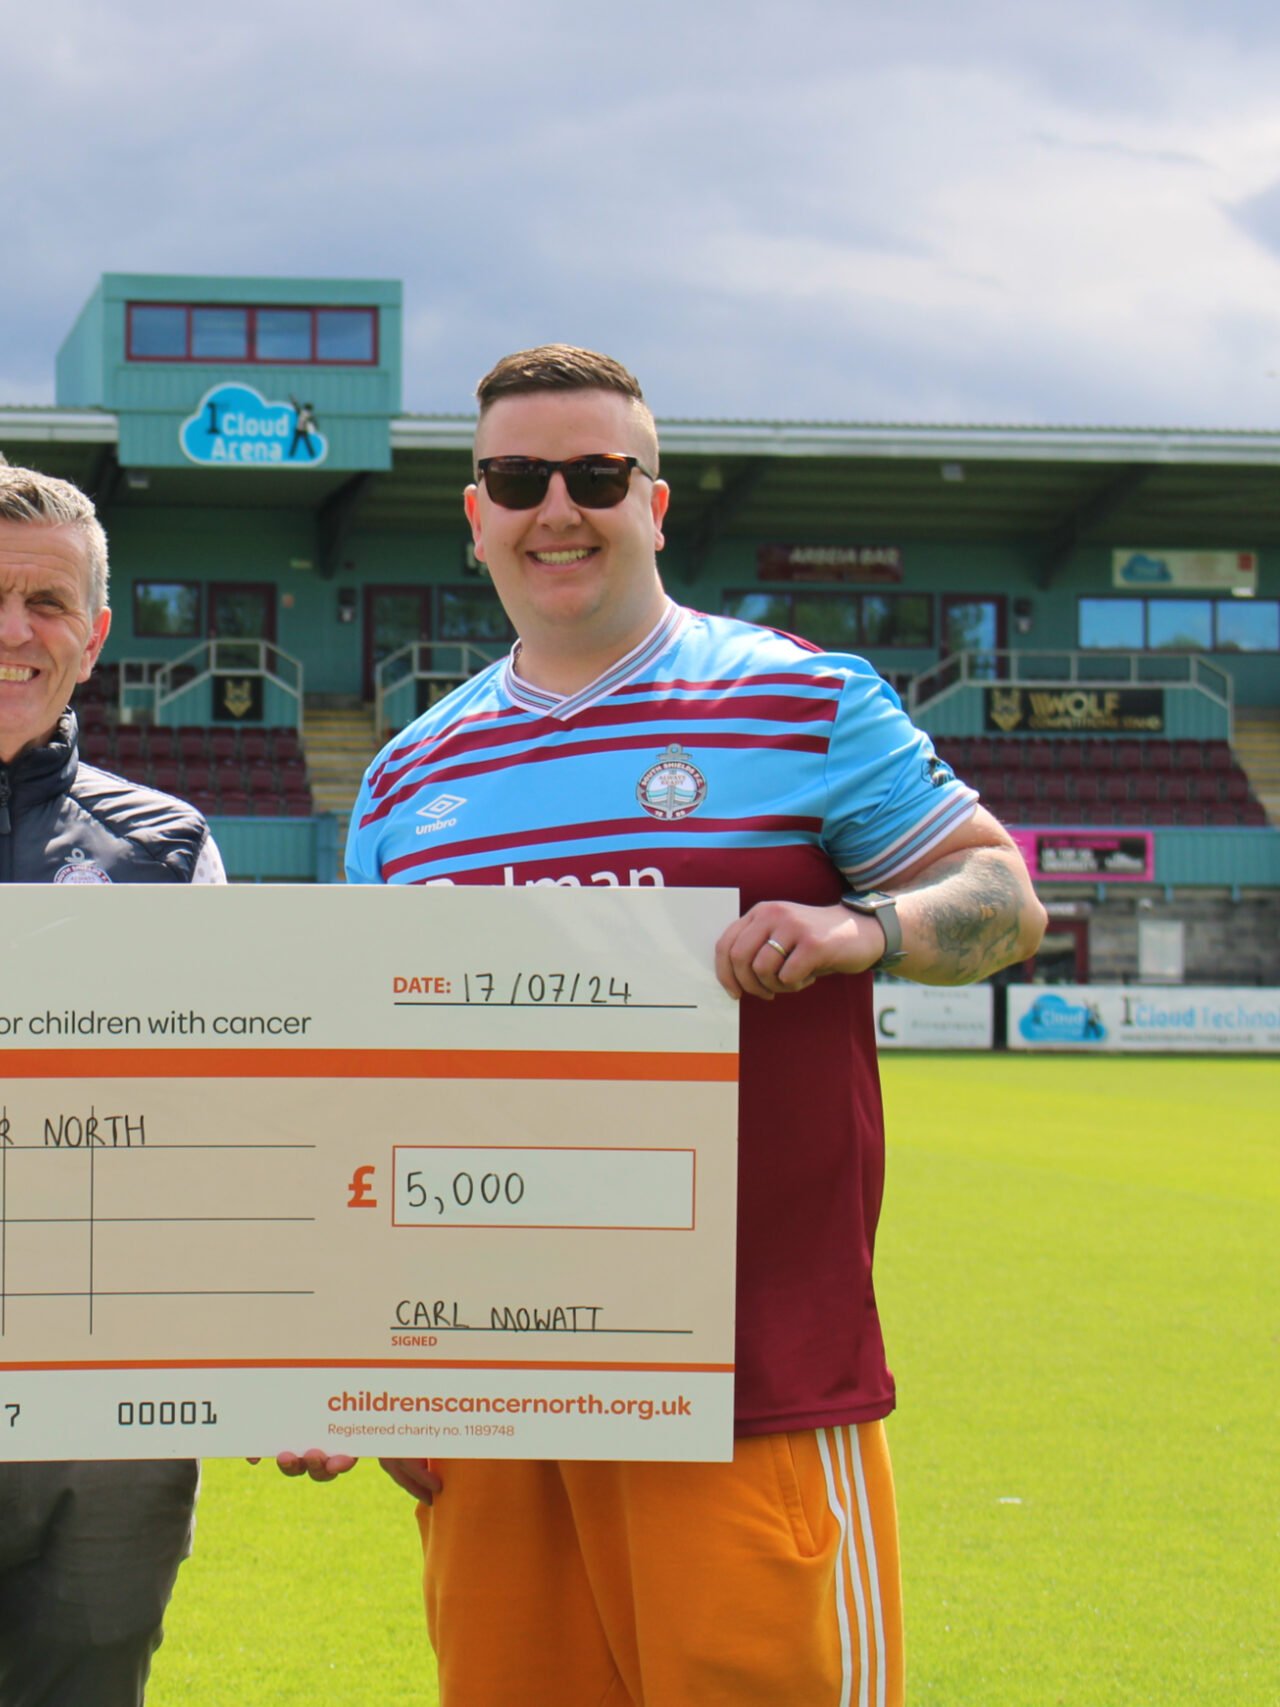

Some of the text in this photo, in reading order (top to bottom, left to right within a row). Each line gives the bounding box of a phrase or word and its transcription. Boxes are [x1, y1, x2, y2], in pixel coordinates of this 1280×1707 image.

[222, 412, 289, 437] Cloud
[210, 437, 283, 462] Arena
[1029, 691, 1121, 717] WOLF
[415, 820, 457, 836] umbro
[393, 976, 452, 994] DATE:
[28, 1009, 141, 1036] children
[147, 1009, 206, 1035] with
[212, 1015, 312, 1035] cancer
[1135, 1003, 1195, 1028] Cloud
[44, 1114, 147, 1149] NORTH
[347, 1164, 526, 1215] £ 5,000
[395, 1299, 604, 1333] CARL MOWATT
[391, 1335, 438, 1347] SIGNED
[117, 1400, 218, 1427] 00001
[327, 1390, 692, 1420] childrenscancernorth.org.uk
[327, 1423, 515, 1438] Registered charity no. 1189748
